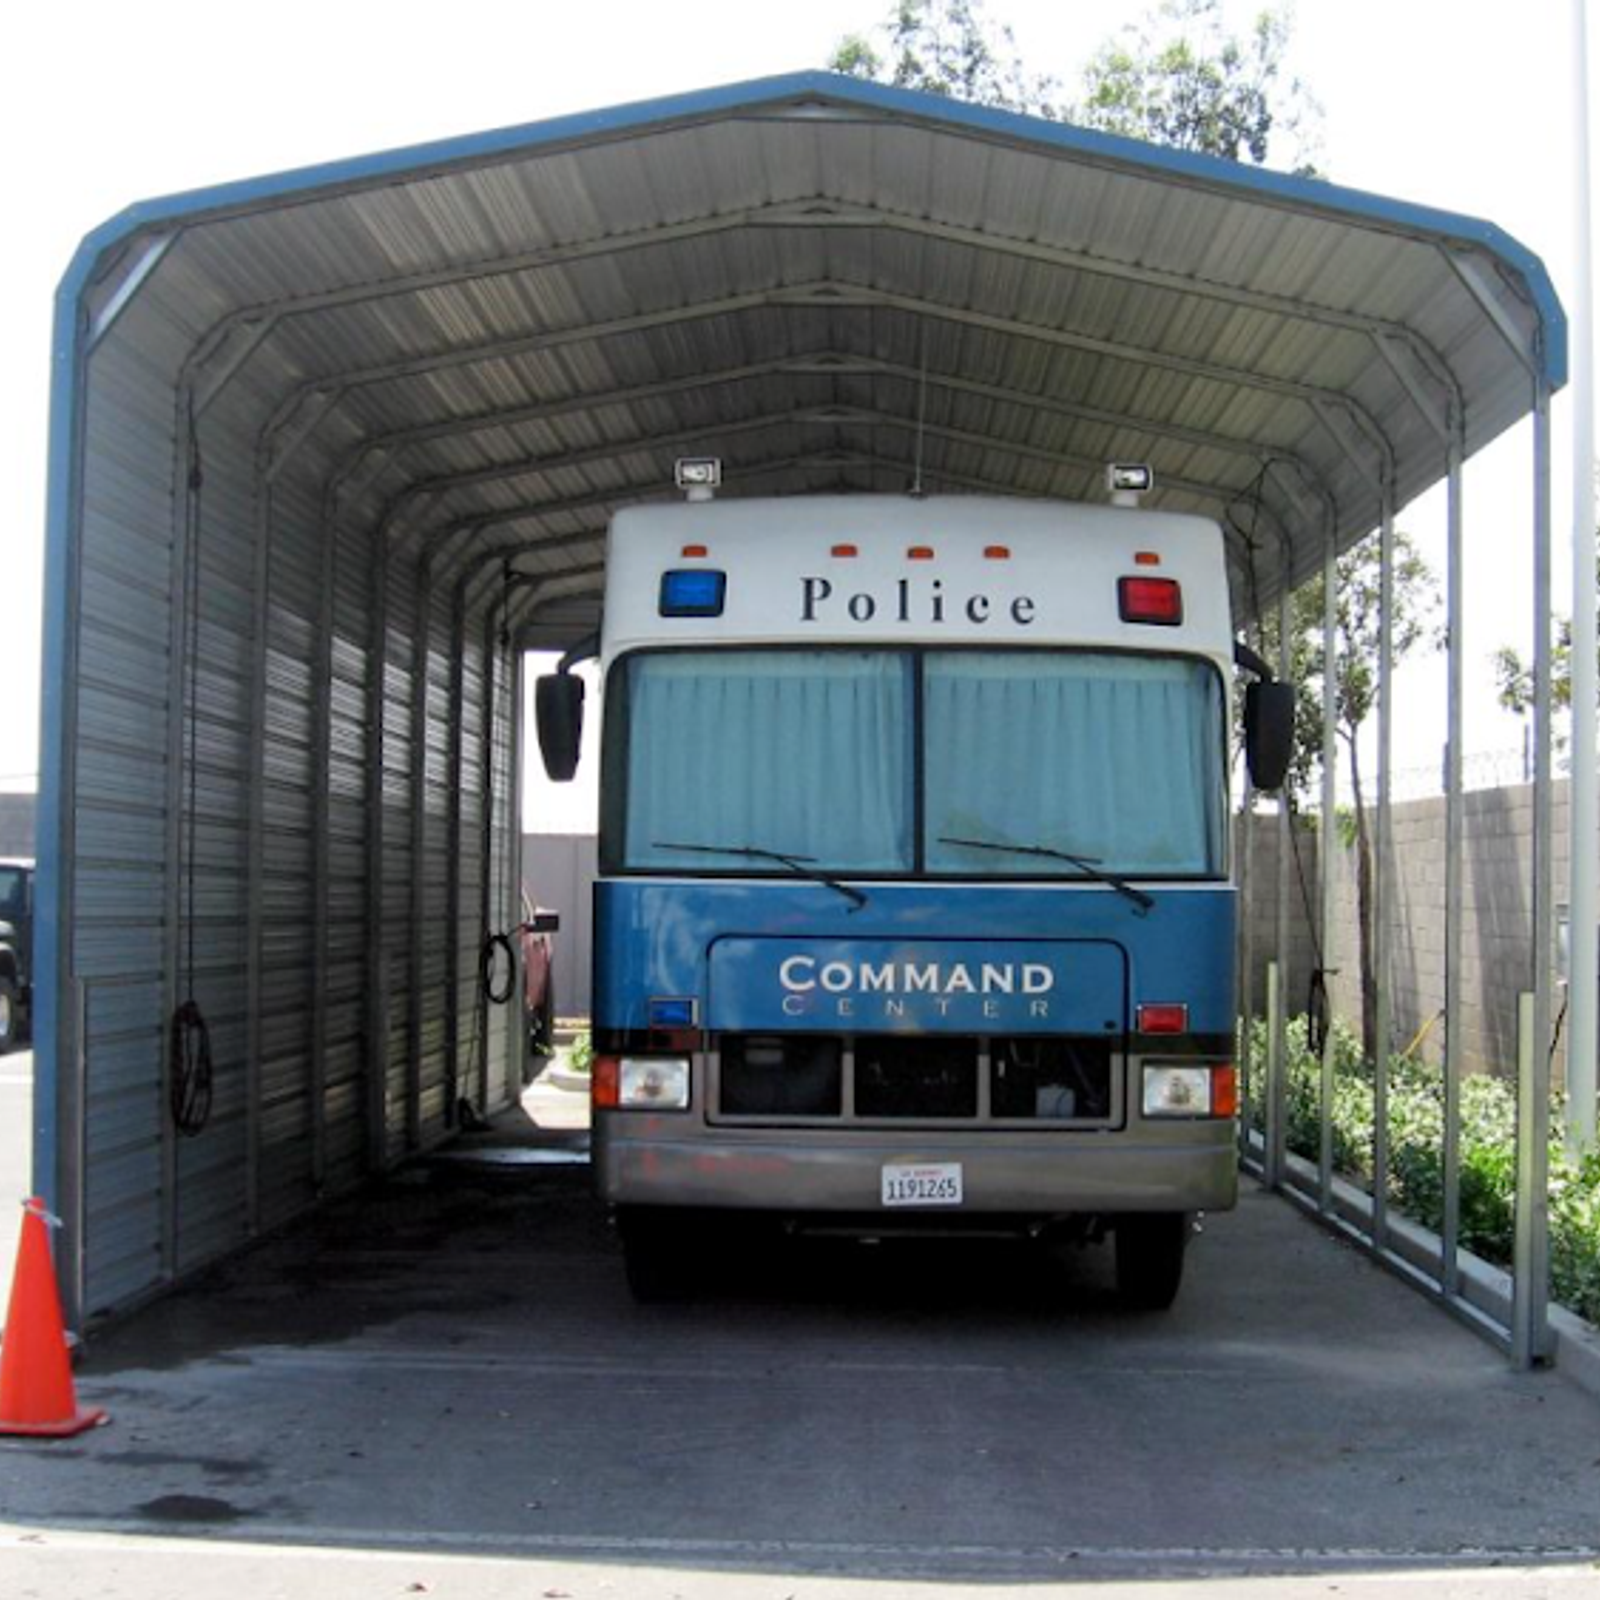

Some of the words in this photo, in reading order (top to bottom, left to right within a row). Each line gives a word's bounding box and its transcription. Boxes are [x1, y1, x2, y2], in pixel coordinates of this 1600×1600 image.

[800, 577, 1035, 625] Police
[779, 955, 1054, 993] COMMAND
[781, 995, 1050, 1018] CENTER
[887, 1178, 957, 1200] 1191265
